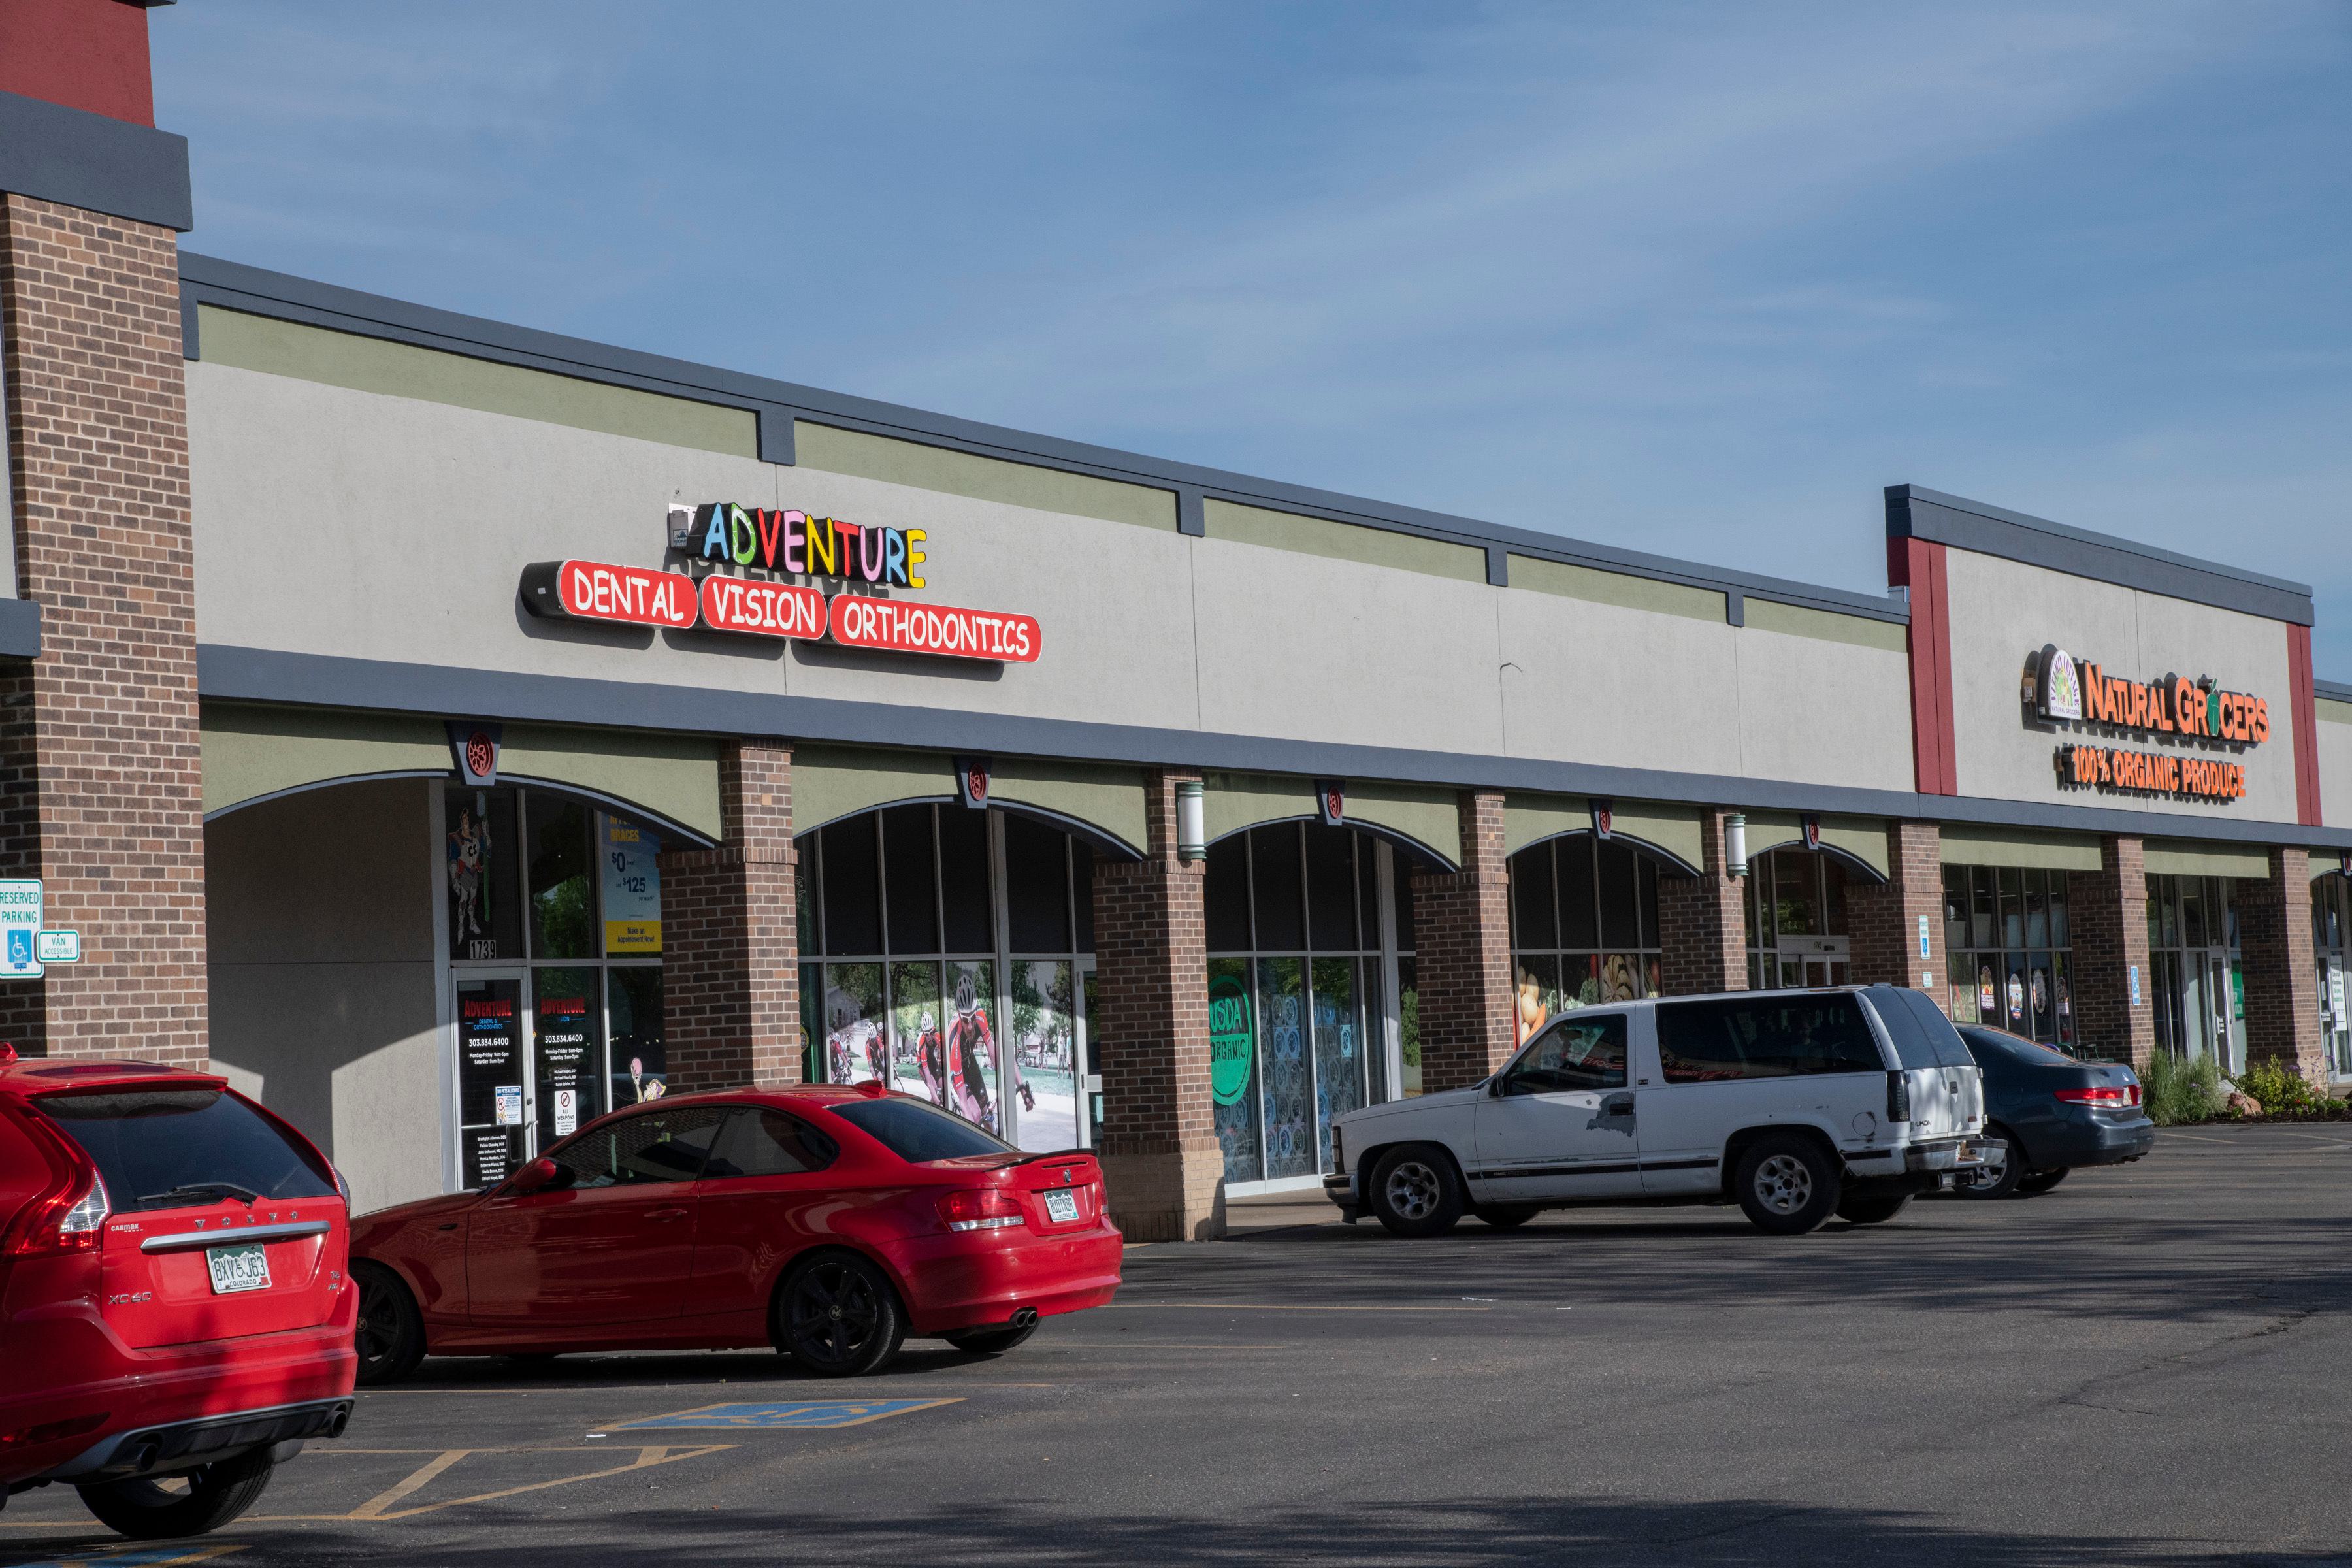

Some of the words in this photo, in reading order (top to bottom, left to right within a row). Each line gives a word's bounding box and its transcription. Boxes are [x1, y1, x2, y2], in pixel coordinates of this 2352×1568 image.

[704, 502, 926, 589] ADVENTURE
[574, 567, 685, 622] DENTAL
[713, 585, 817, 632] VISION
[843, 602, 1030, 657] ORTHODONTICS
[2085, 661, 2174, 731] NATURAL
[2073, 746, 2110, 785] 100%
[2112, 749, 2179, 792] ORGANIC
[2183, 759, 2246, 798] PRODUCE
[612, 852, 625, 872] $0
[622, 877, 646, 892] $125
[0, 892, 39, 904] RESERVED
[2, 911, 37, 923] PARKING
[52, 937, 65, 946] VAN
[617, 935, 644, 943] Appointment
[470, 940, 497, 959] 1739
[465, 998, 512, 1017] ADVENTURE
[540, 996, 585, 1014] ADVENTURE
[1209, 997, 1242, 1033] USDA
[468, 1037, 509, 1047] 303.834.6400
[545, 1034, 583, 1043] 303.834.6400
[1210, 1039, 1246, 1062] ORGANIC
[194, 1211, 298, 1229] VOLVO
[229, 1279, 257, 1287] COLORADO
[108, 1292, 152, 1305] XC60
